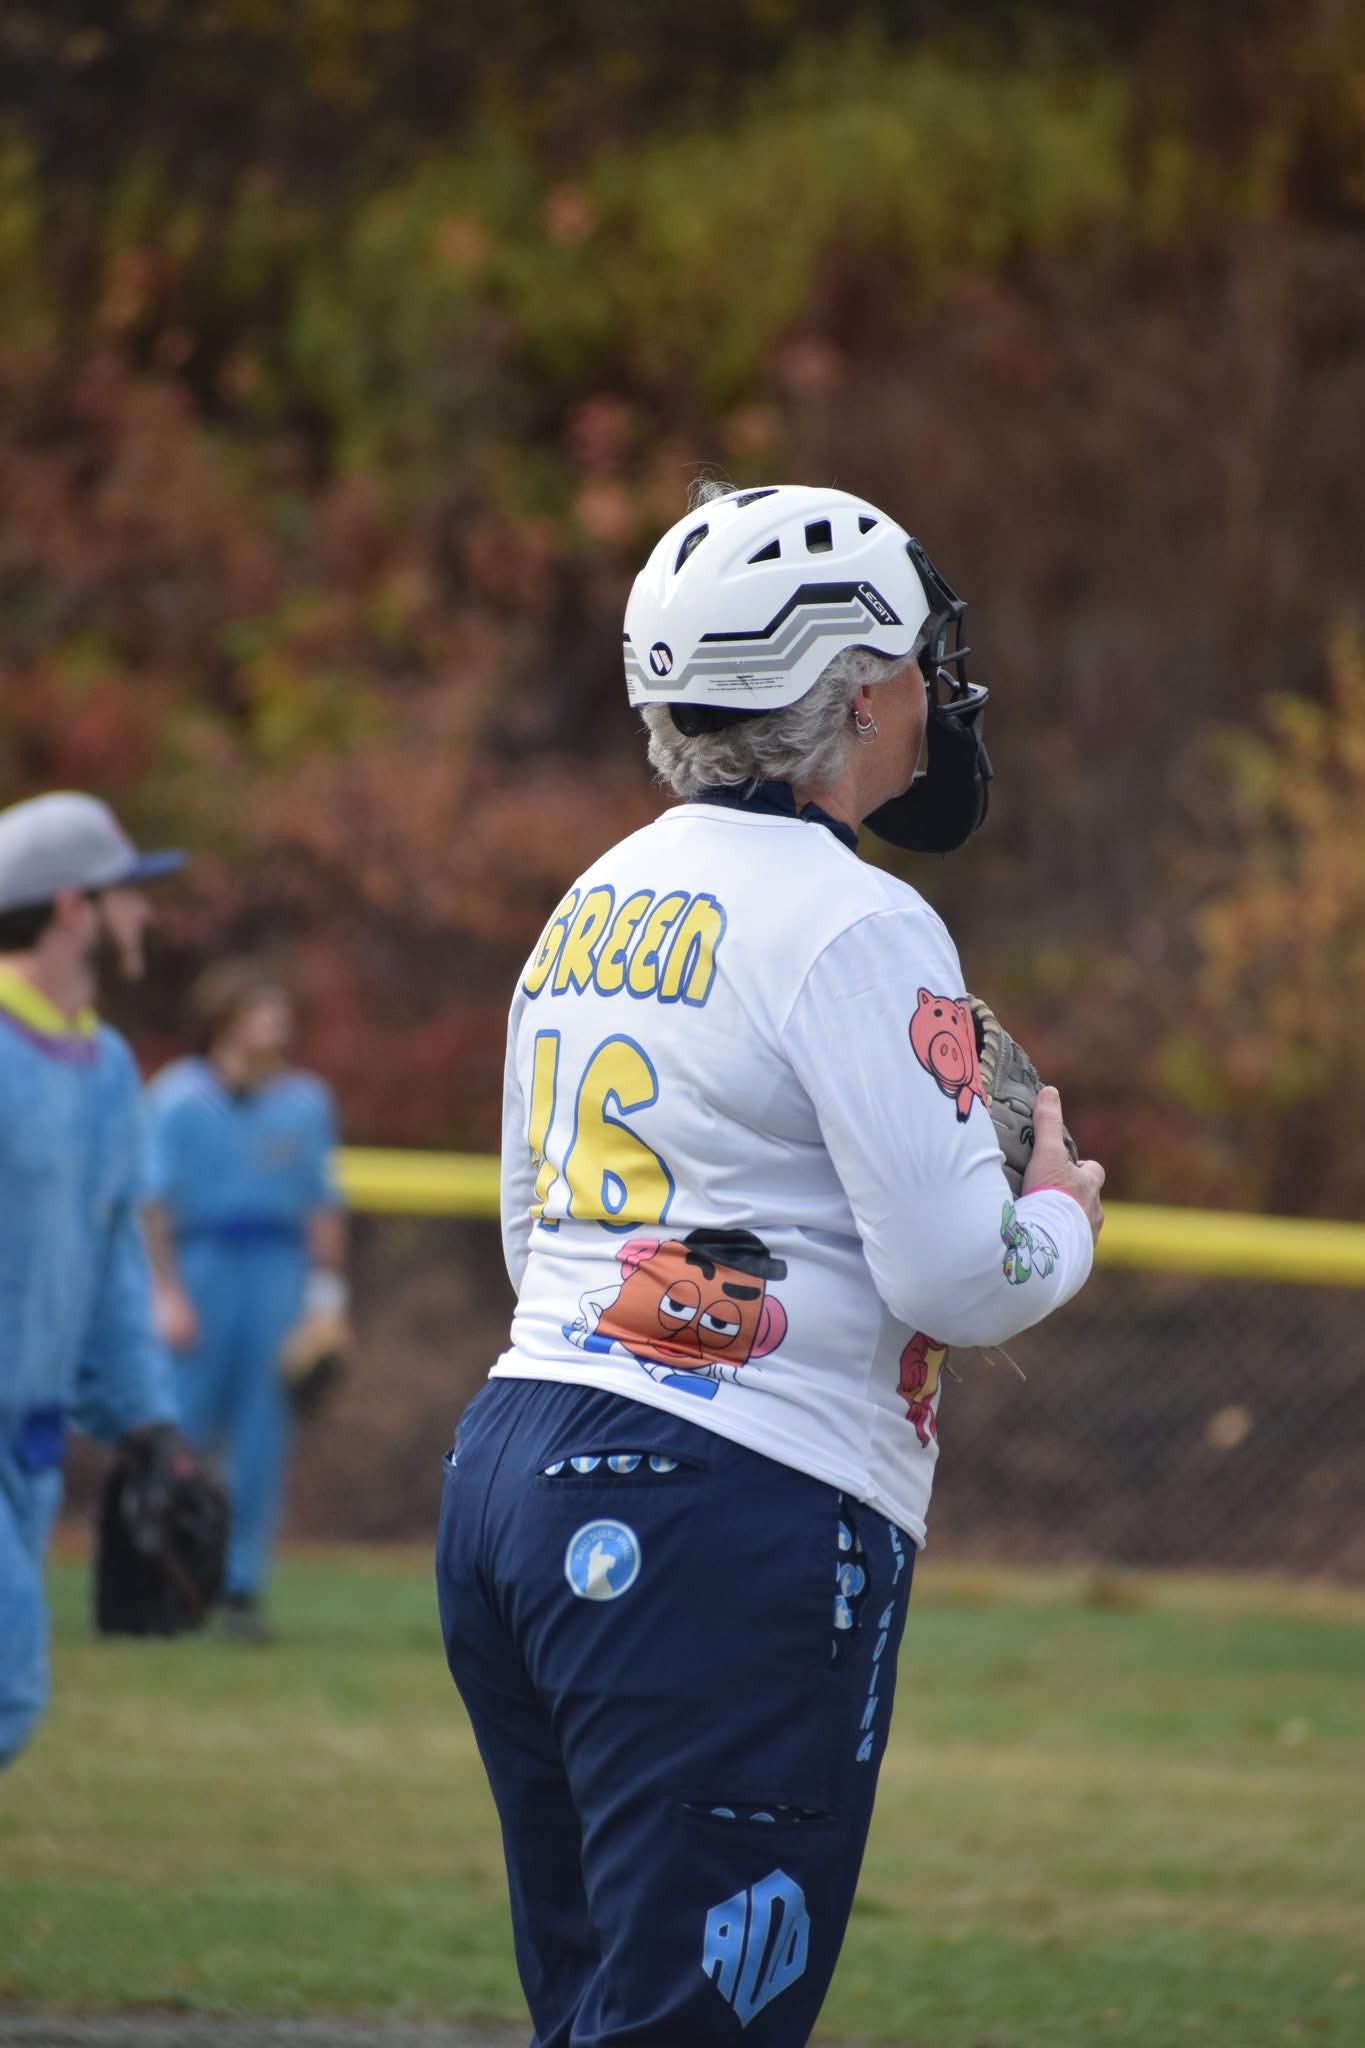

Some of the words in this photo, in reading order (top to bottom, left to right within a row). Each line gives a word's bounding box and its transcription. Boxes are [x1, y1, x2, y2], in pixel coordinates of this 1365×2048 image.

[858, 583, 895, 622] LEGIT
[521, 883, 728, 1009] GREEN
[528, 1029, 676, 1235] 16
